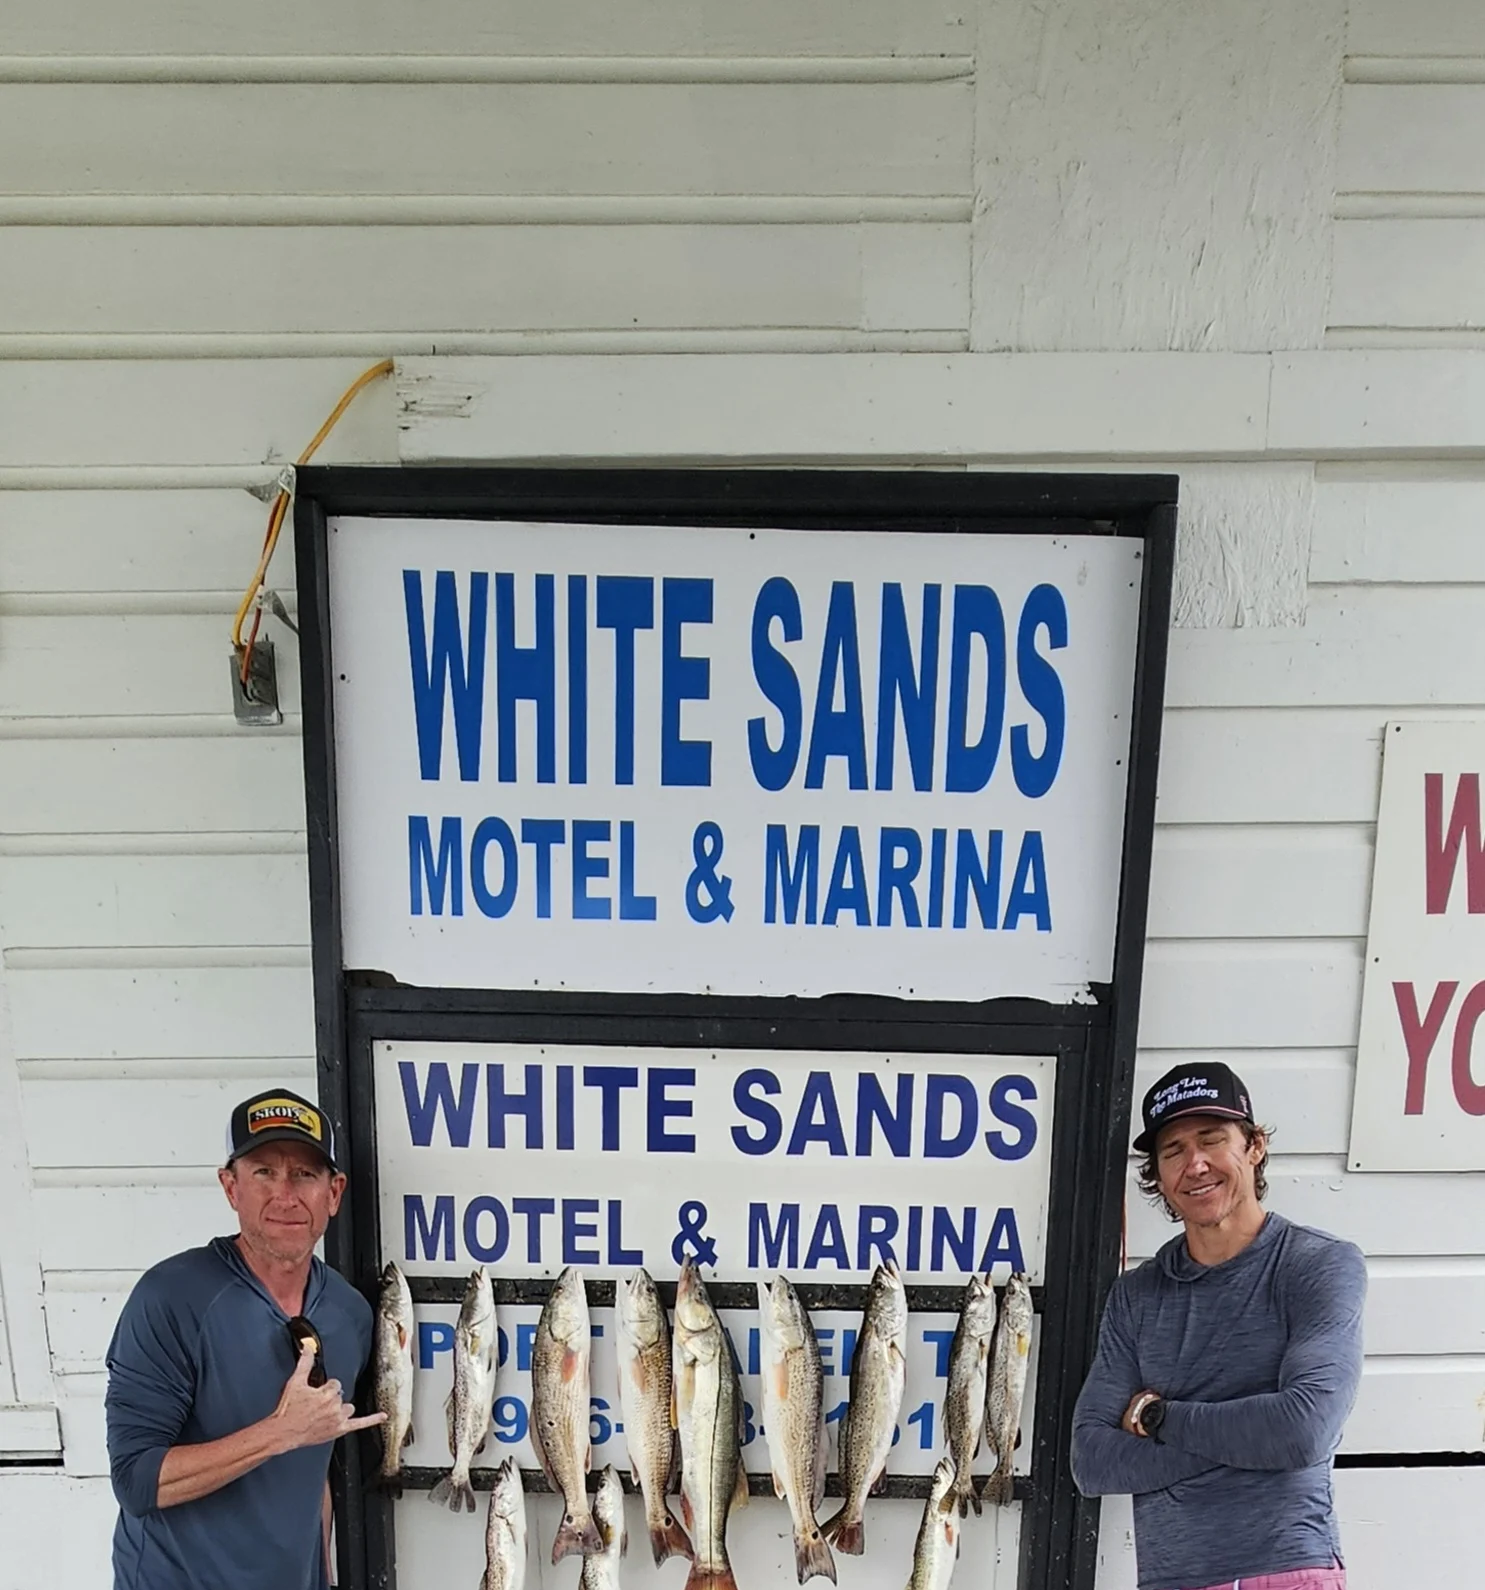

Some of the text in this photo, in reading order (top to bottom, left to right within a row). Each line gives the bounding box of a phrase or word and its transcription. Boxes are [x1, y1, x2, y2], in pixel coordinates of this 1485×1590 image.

[402, 568, 1070, 799] WHITE SANDS
[408, 814, 1053, 932] MOTEL & MARINA
[399, 1061, 1038, 1162] WHITE SANDS
[1150, 1086, 1219, 1118] The Matadors
[1153, 1076, 1207, 1101] Long Live
[405, 1196, 1026, 1273] MOTEL & MARINA
